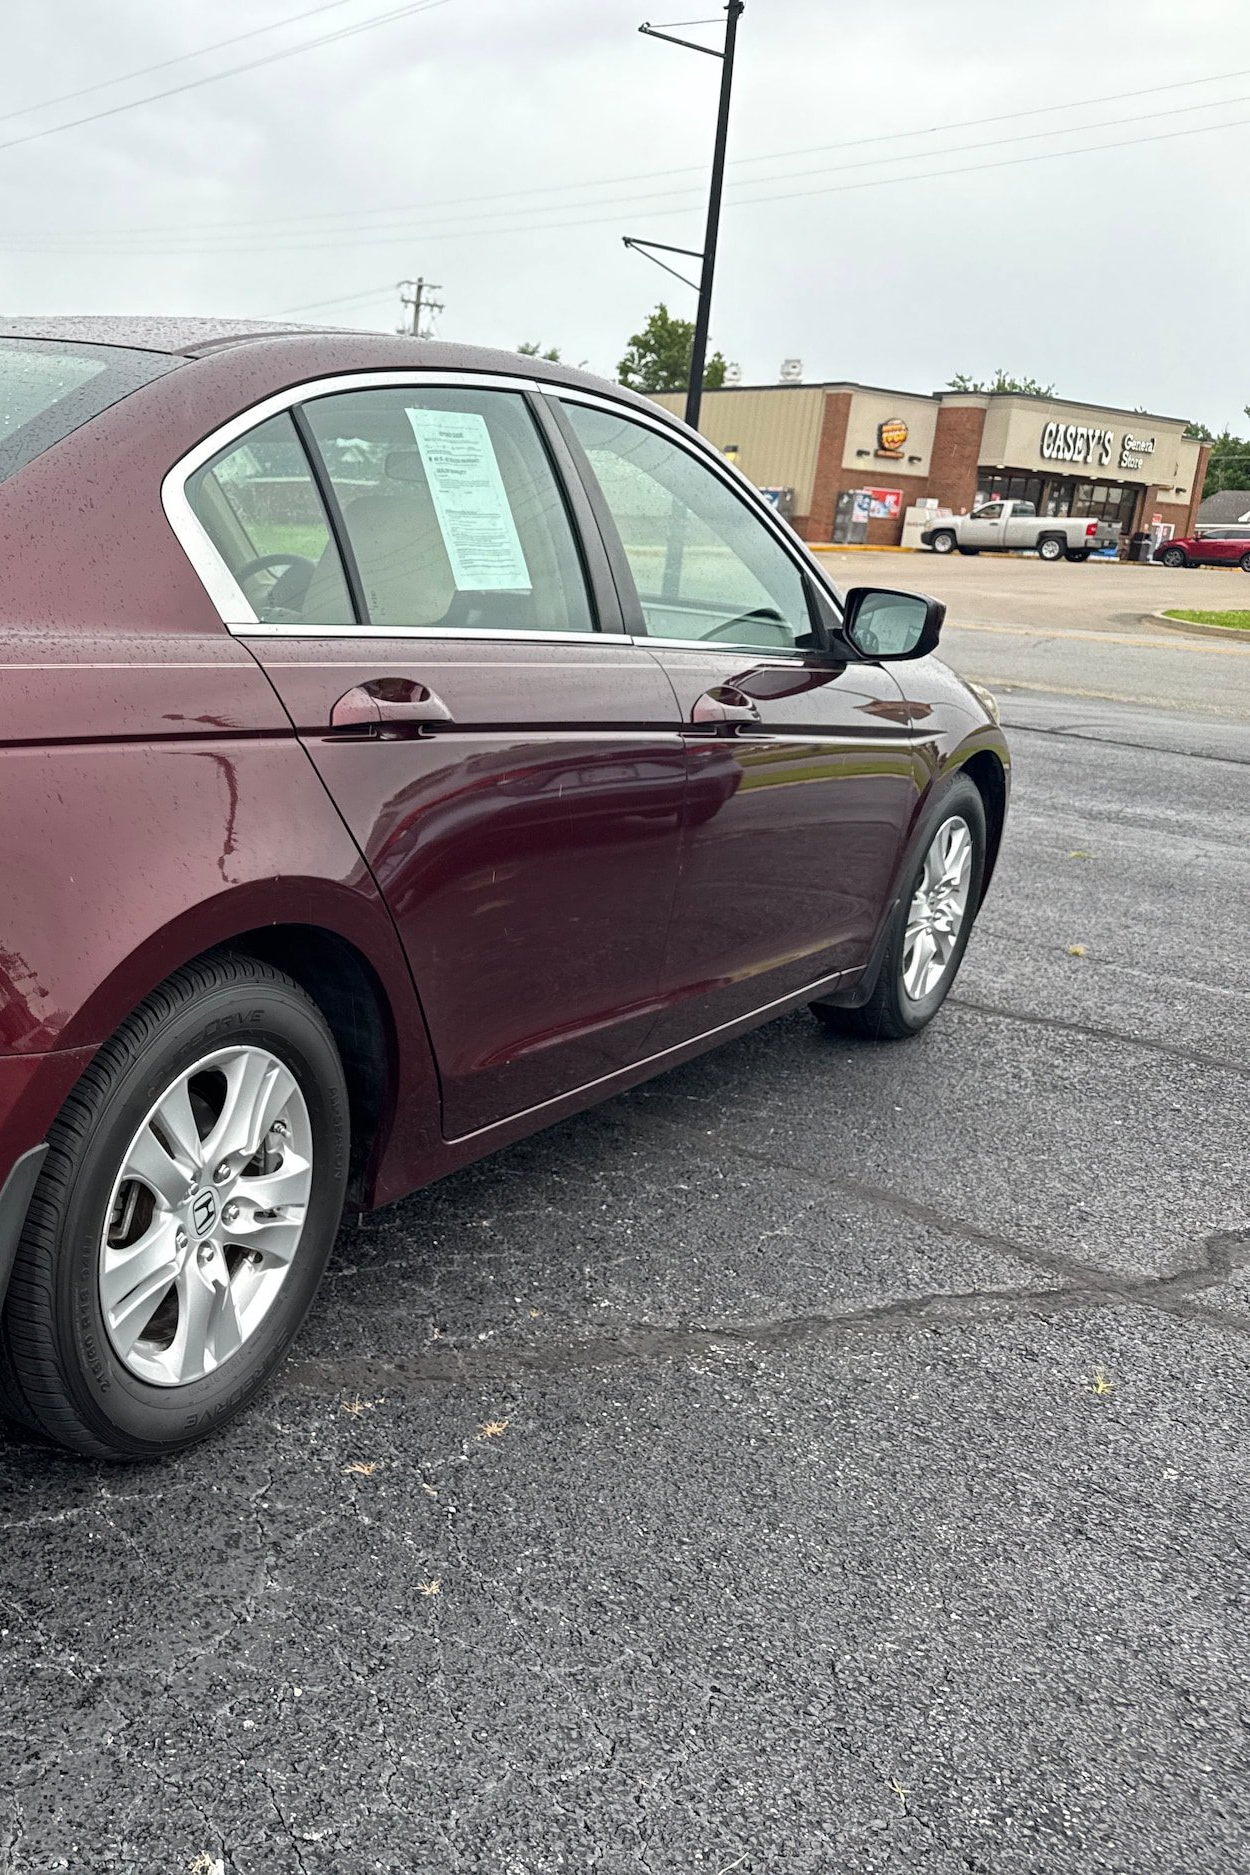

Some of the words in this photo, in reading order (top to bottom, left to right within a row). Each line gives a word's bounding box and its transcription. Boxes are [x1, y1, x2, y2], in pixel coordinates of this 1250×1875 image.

[1042, 421, 1114, 465] CASEY'S
[1124, 433, 1157, 453] General
[1121, 451, 1143, 469] Store
